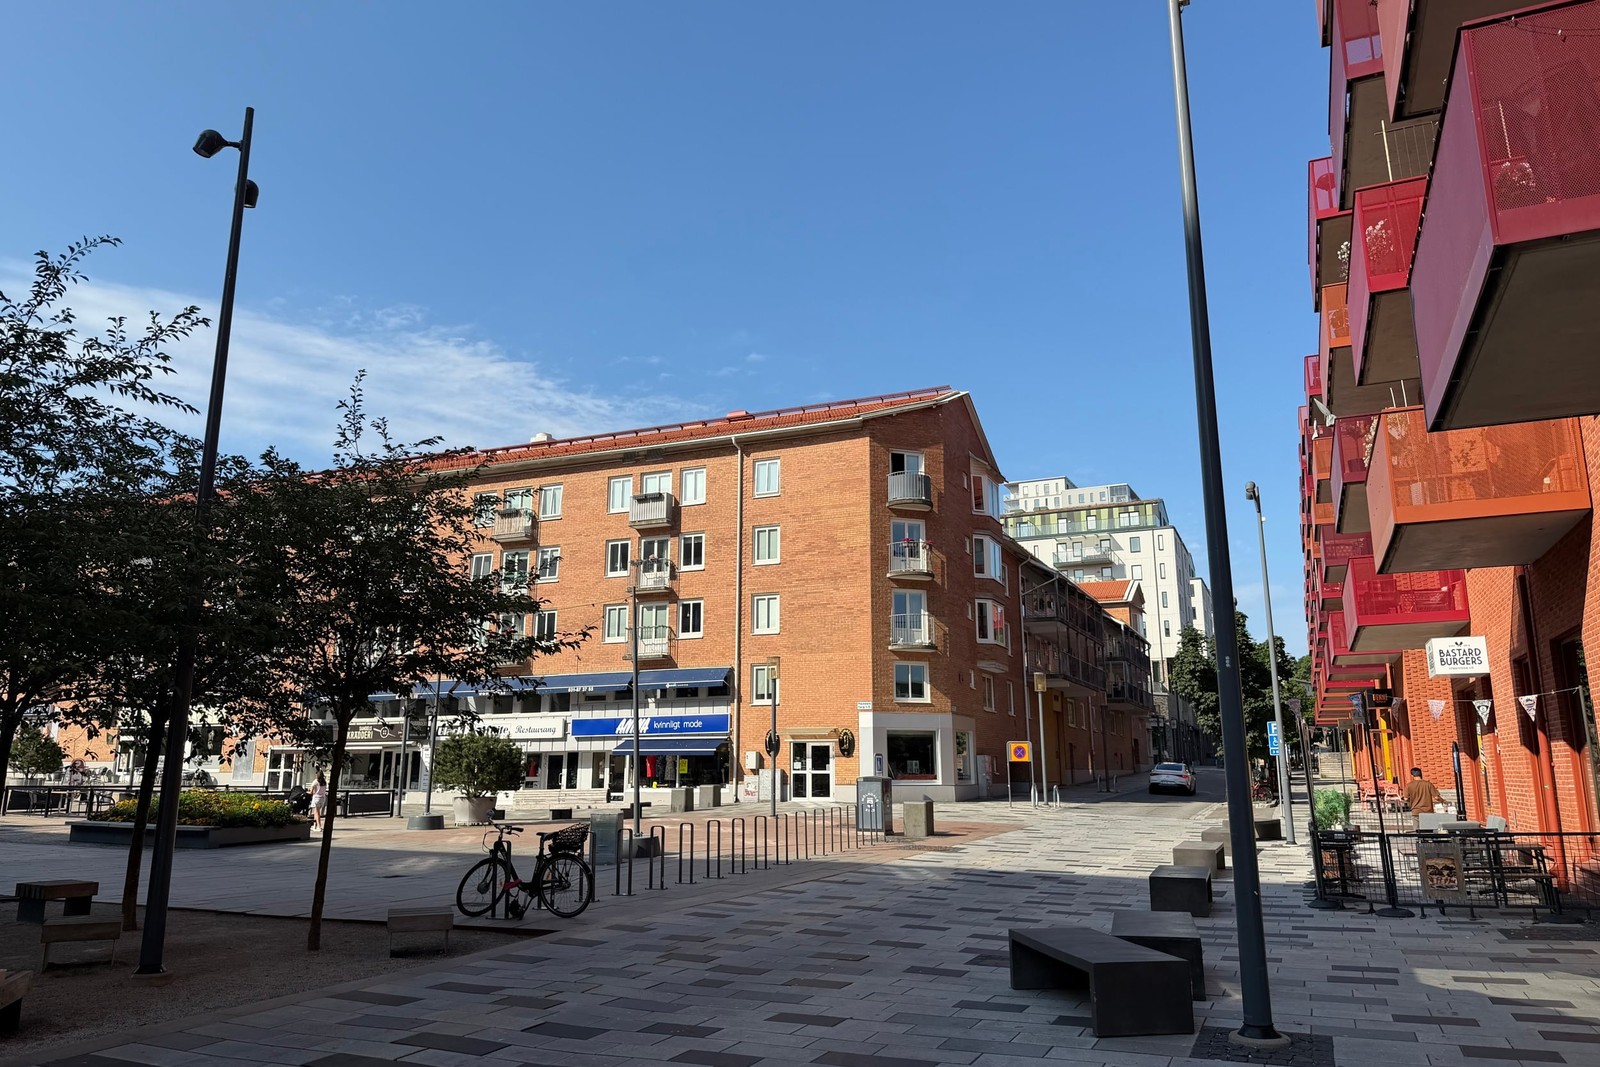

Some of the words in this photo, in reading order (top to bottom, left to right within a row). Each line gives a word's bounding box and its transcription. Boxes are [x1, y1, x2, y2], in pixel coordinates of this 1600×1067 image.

[1439, 648, 1482, 658] BASTARD
[1440, 656, 1483, 666] BURGERS
[514, 725, 557, 734] Restaurang
[653, 720, 681, 731] kvinnligt
[683, 719, 703, 728] mode
